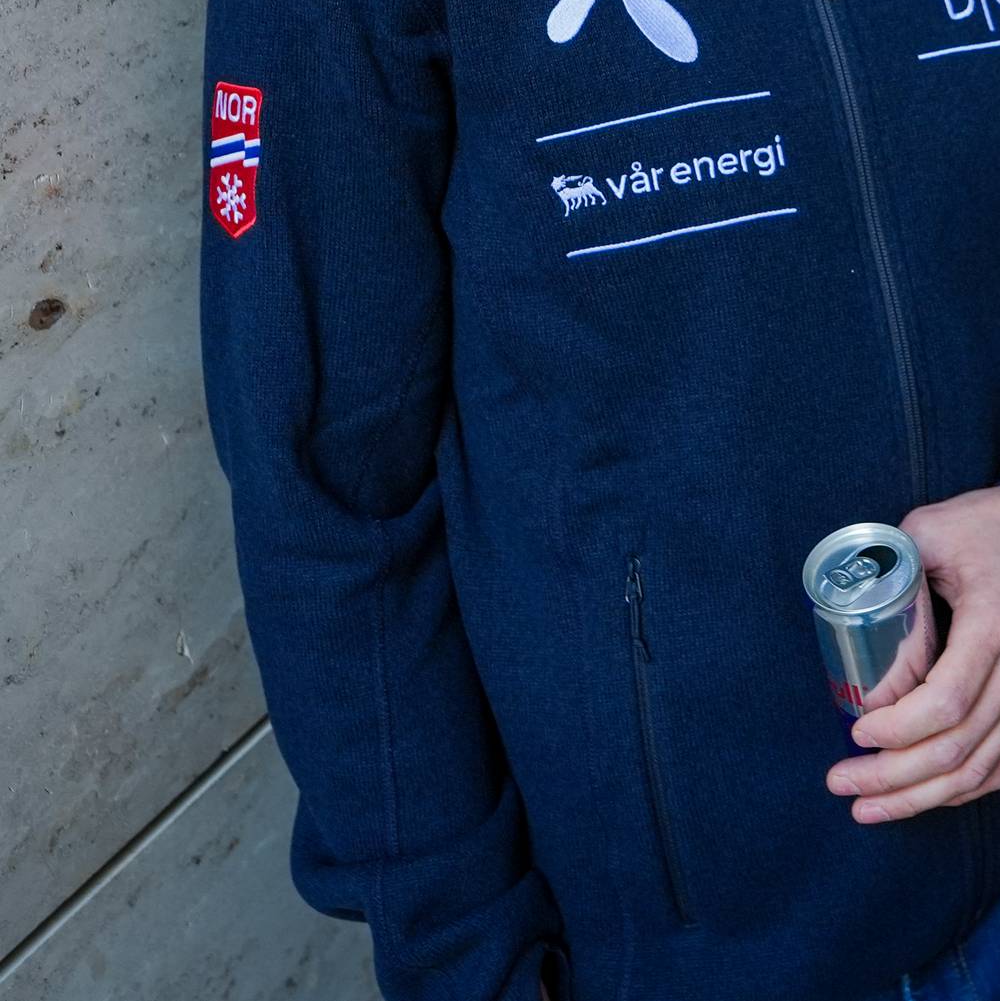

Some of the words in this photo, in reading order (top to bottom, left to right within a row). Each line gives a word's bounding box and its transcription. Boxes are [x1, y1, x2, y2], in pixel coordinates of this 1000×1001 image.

[215, 89, 258, 126] NOR
[605, 160, 664, 200] vår
[669, 134, 786, 177] energi
